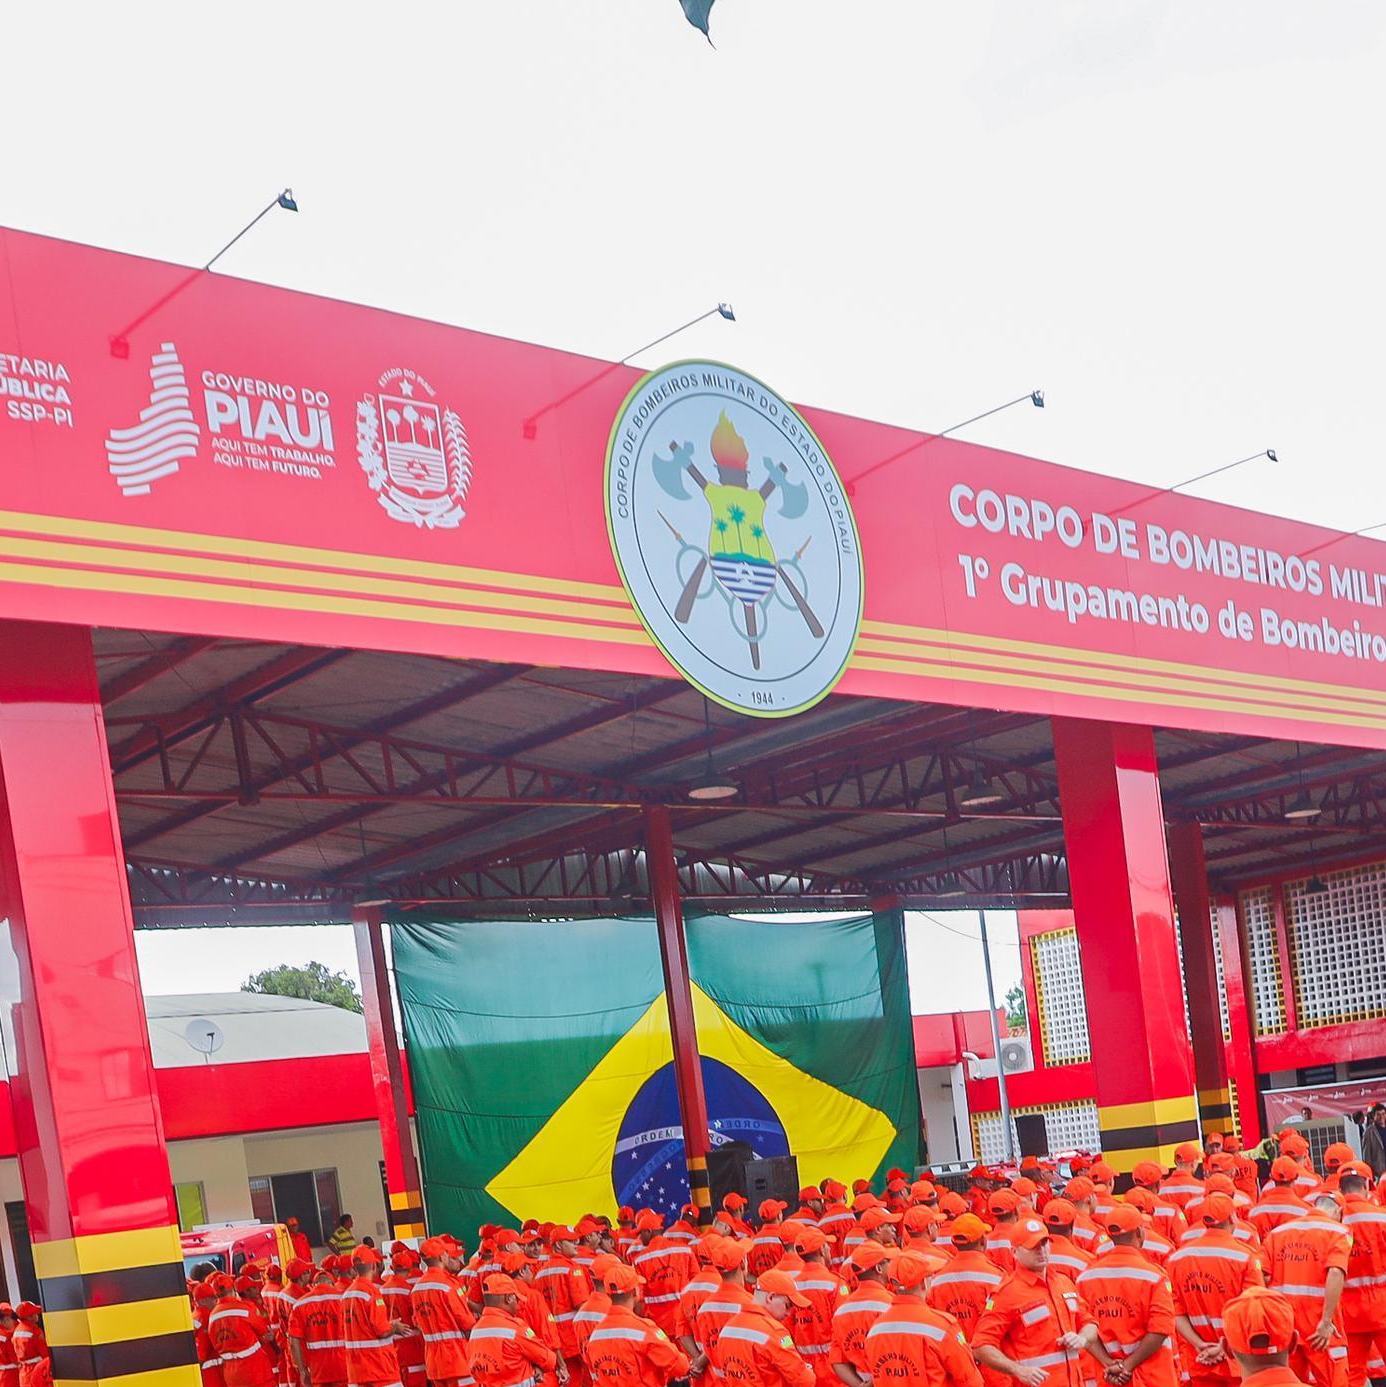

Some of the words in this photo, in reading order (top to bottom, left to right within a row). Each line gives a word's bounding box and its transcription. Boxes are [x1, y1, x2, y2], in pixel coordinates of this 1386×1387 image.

[403, 368, 416, 379] DO
[702, 372, 756, 401] MILITAR
[201, 370, 297, 401] GOVERNO
[302, 388, 329, 408] DO
[633, 373, 699, 431] BOMBEIROS
[7, 400, 73, 428] SSP-PI
[759, 395, 779, 416] DO
[211, 437, 241, 451] AQUI
[243, 441, 267, 455] TEM
[623, 430, 639, 453] DE
[780, 414, 827, 477] ESTADO
[213, 451, 243, 468] AQUI
[245, 457, 270, 471] TEM
[618, 452, 632, 519] CORPO
[824, 479, 840, 511] DO
[949, 483, 1085, 549] CORPO
[1091, 511, 1141, 560] DE
[1145, 521, 1325, 597] BOMBEIROS
[1000, 561, 1210, 634] Grupamento
[1218, 600, 1254, 642] de
[751, 691, 774, 705] 1944
[634, 1128, 674, 1145] ORDEM
